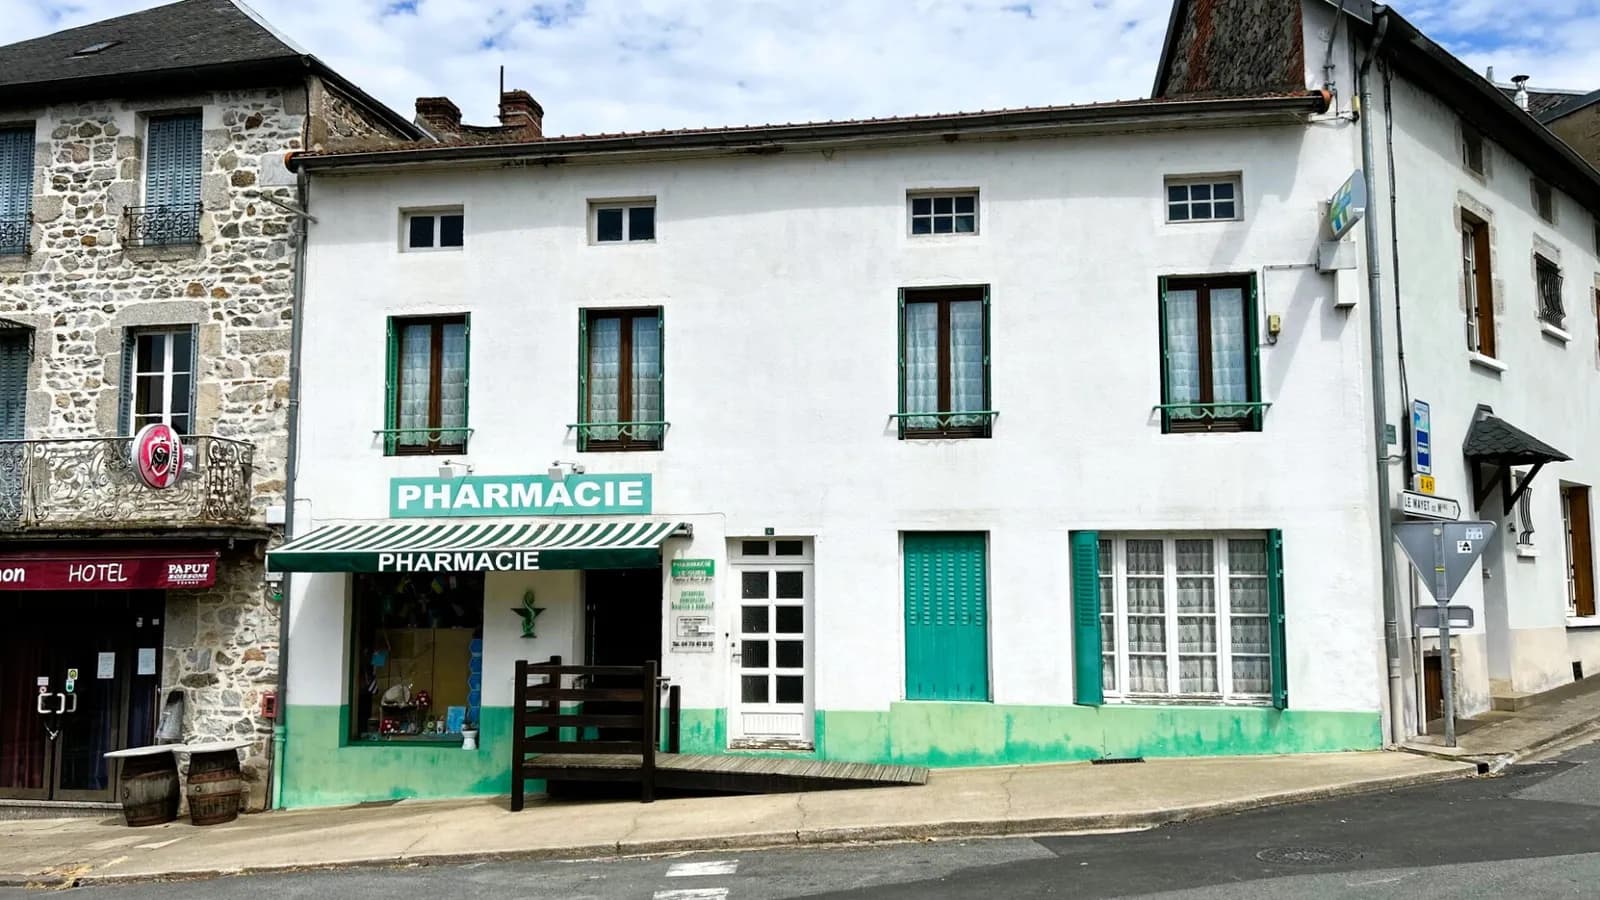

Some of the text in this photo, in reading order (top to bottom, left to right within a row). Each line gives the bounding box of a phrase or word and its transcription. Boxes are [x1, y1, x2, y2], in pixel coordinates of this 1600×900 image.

[397, 481, 643, 510] PHARMACIE
[1405, 496, 1411, 508] LE
[1413, 498, 1430, 511] MAYET
[168, 563, 210, 574] PAPUT
[378, 551, 540, 572] PHARMACIE
[68, 563, 128, 583] HOTEL
